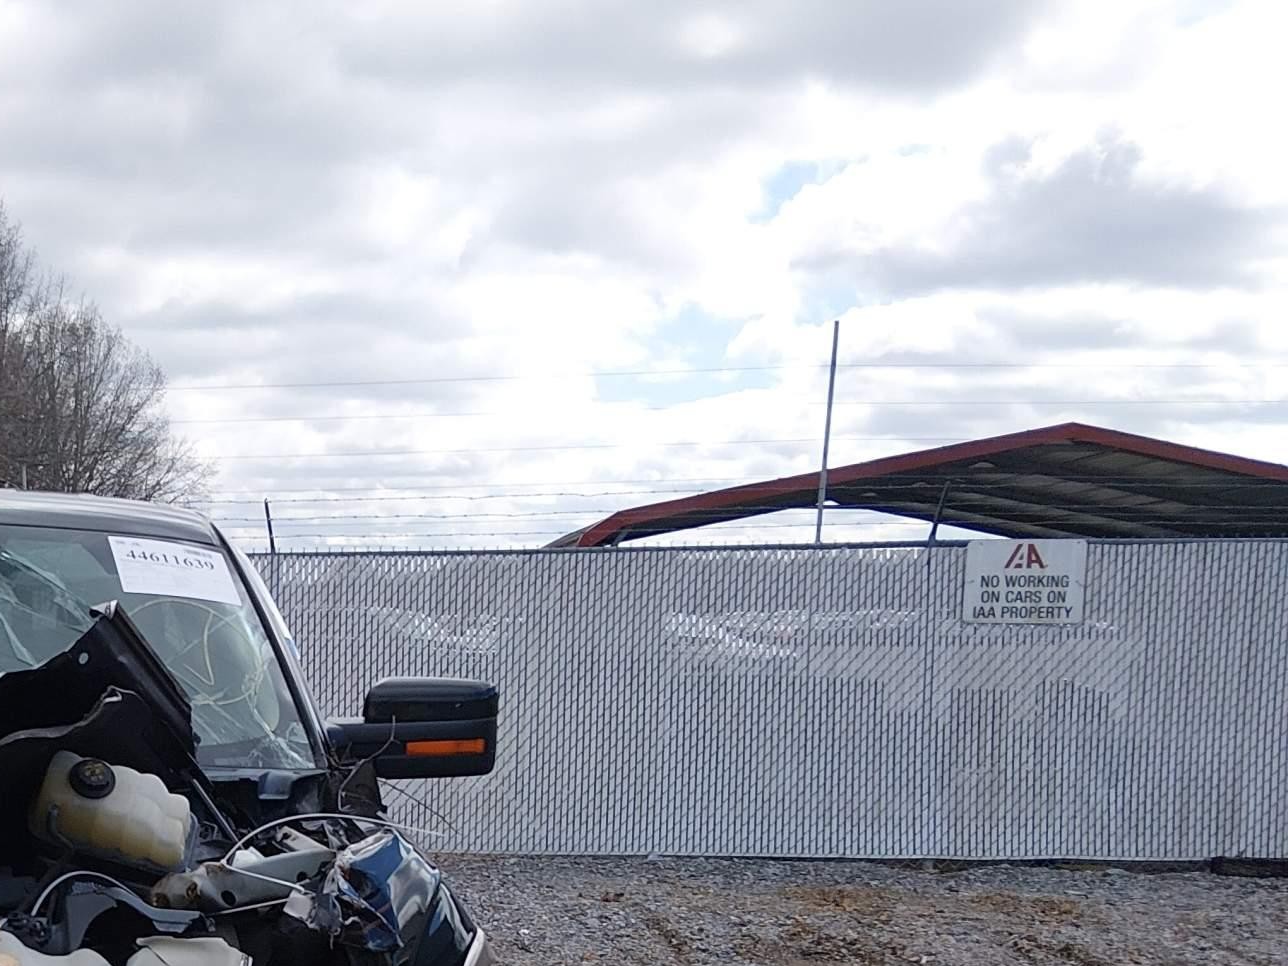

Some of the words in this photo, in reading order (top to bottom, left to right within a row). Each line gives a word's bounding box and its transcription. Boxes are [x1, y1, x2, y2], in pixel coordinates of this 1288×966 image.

[126, 549, 215, 570] 44611639
[980, 575, 1000, 588] NO
[1005, 575, 1070, 588] WORKING
[981, 591, 1000, 603] ON
[1005, 591, 1042, 603] CARS
[1047, 591, 1067, 603] ON
[973, 606, 996, 619] IAA
[1001, 606, 1073, 619] PROPERTY
